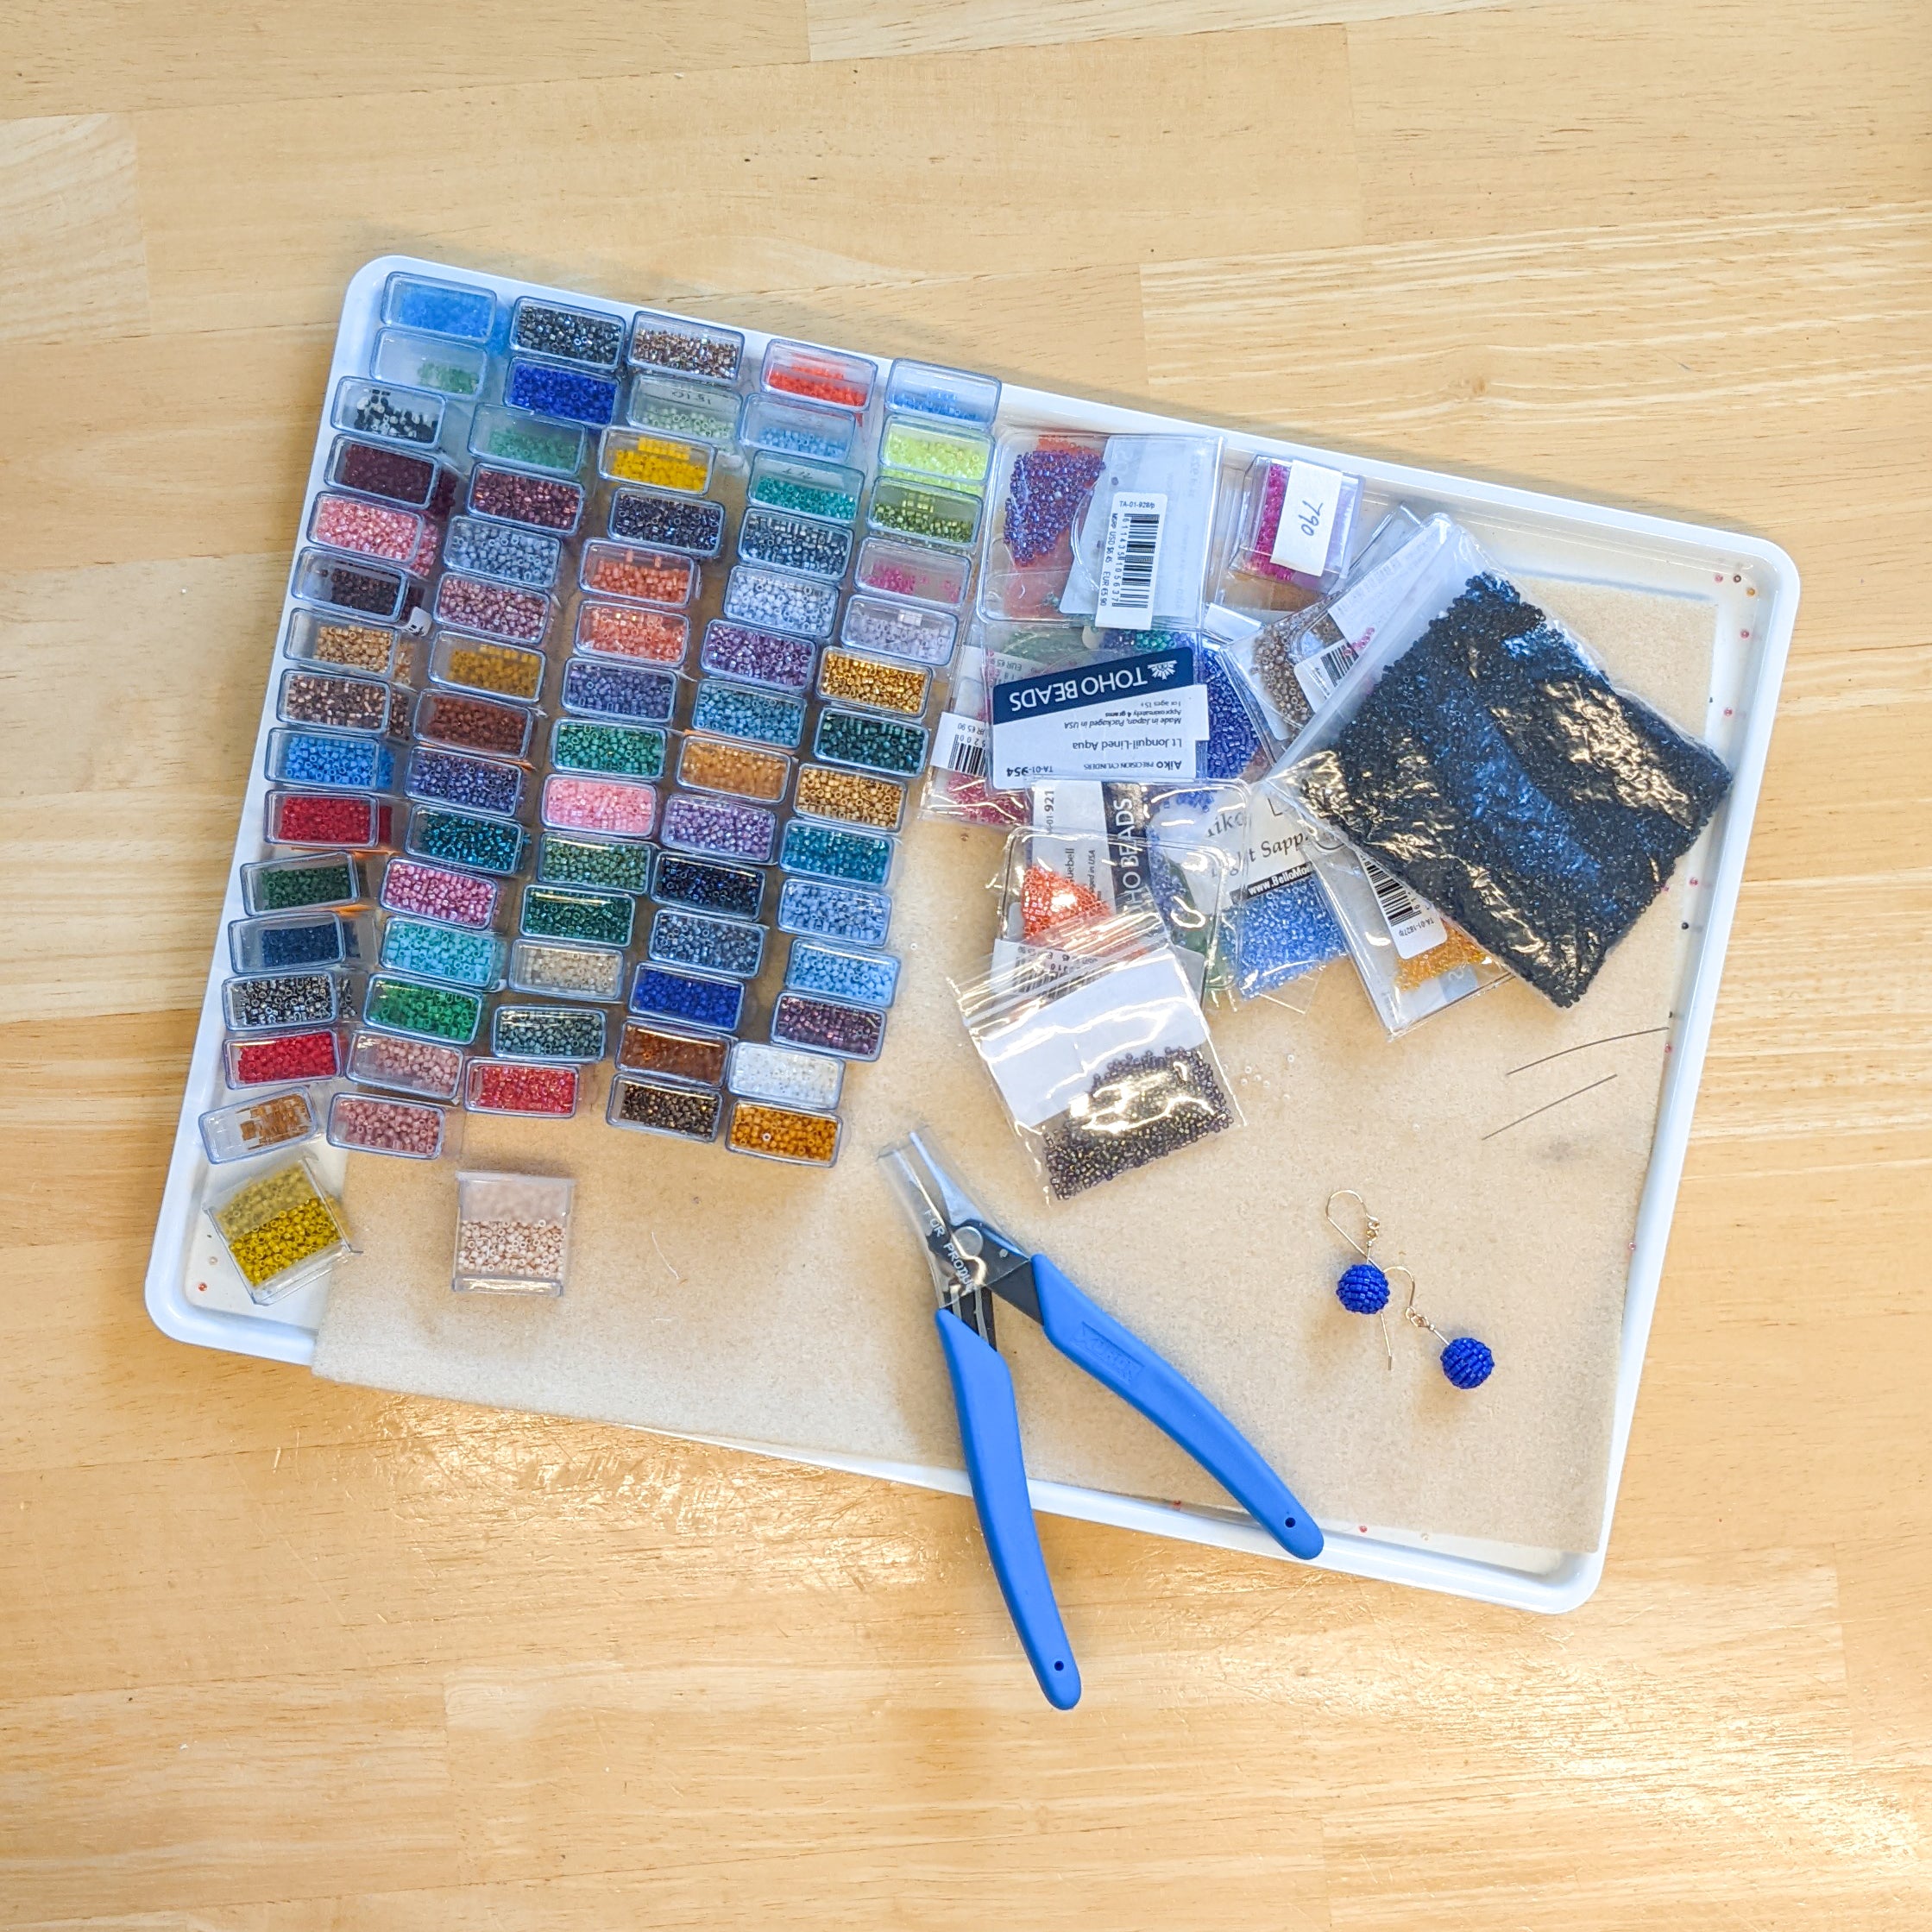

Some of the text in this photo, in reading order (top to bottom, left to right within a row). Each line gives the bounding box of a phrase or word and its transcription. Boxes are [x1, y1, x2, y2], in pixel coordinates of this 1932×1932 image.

[1298, 500, 1324, 537] 790
[1108, 531, 1117, 545] USD
[1102, 571, 1111, 587] EUR
[1009, 666, 1149, 712] TOHO BEADS
[1089, 718, 1125, 728] Packaged
[1072, 737, 1182, 751] Lt Jonquil-Lined Aqua
[1006, 765, 1054, 777] TA-01-954
[1084, 761, 1120, 771] CYLINDERS
[1156, 760, 1182, 771] Aiko
[1113, 798, 1140, 868] BEADS
[1261, 832, 1310, 859] Sapp.
[924, 1210, 946, 1237] FOR
